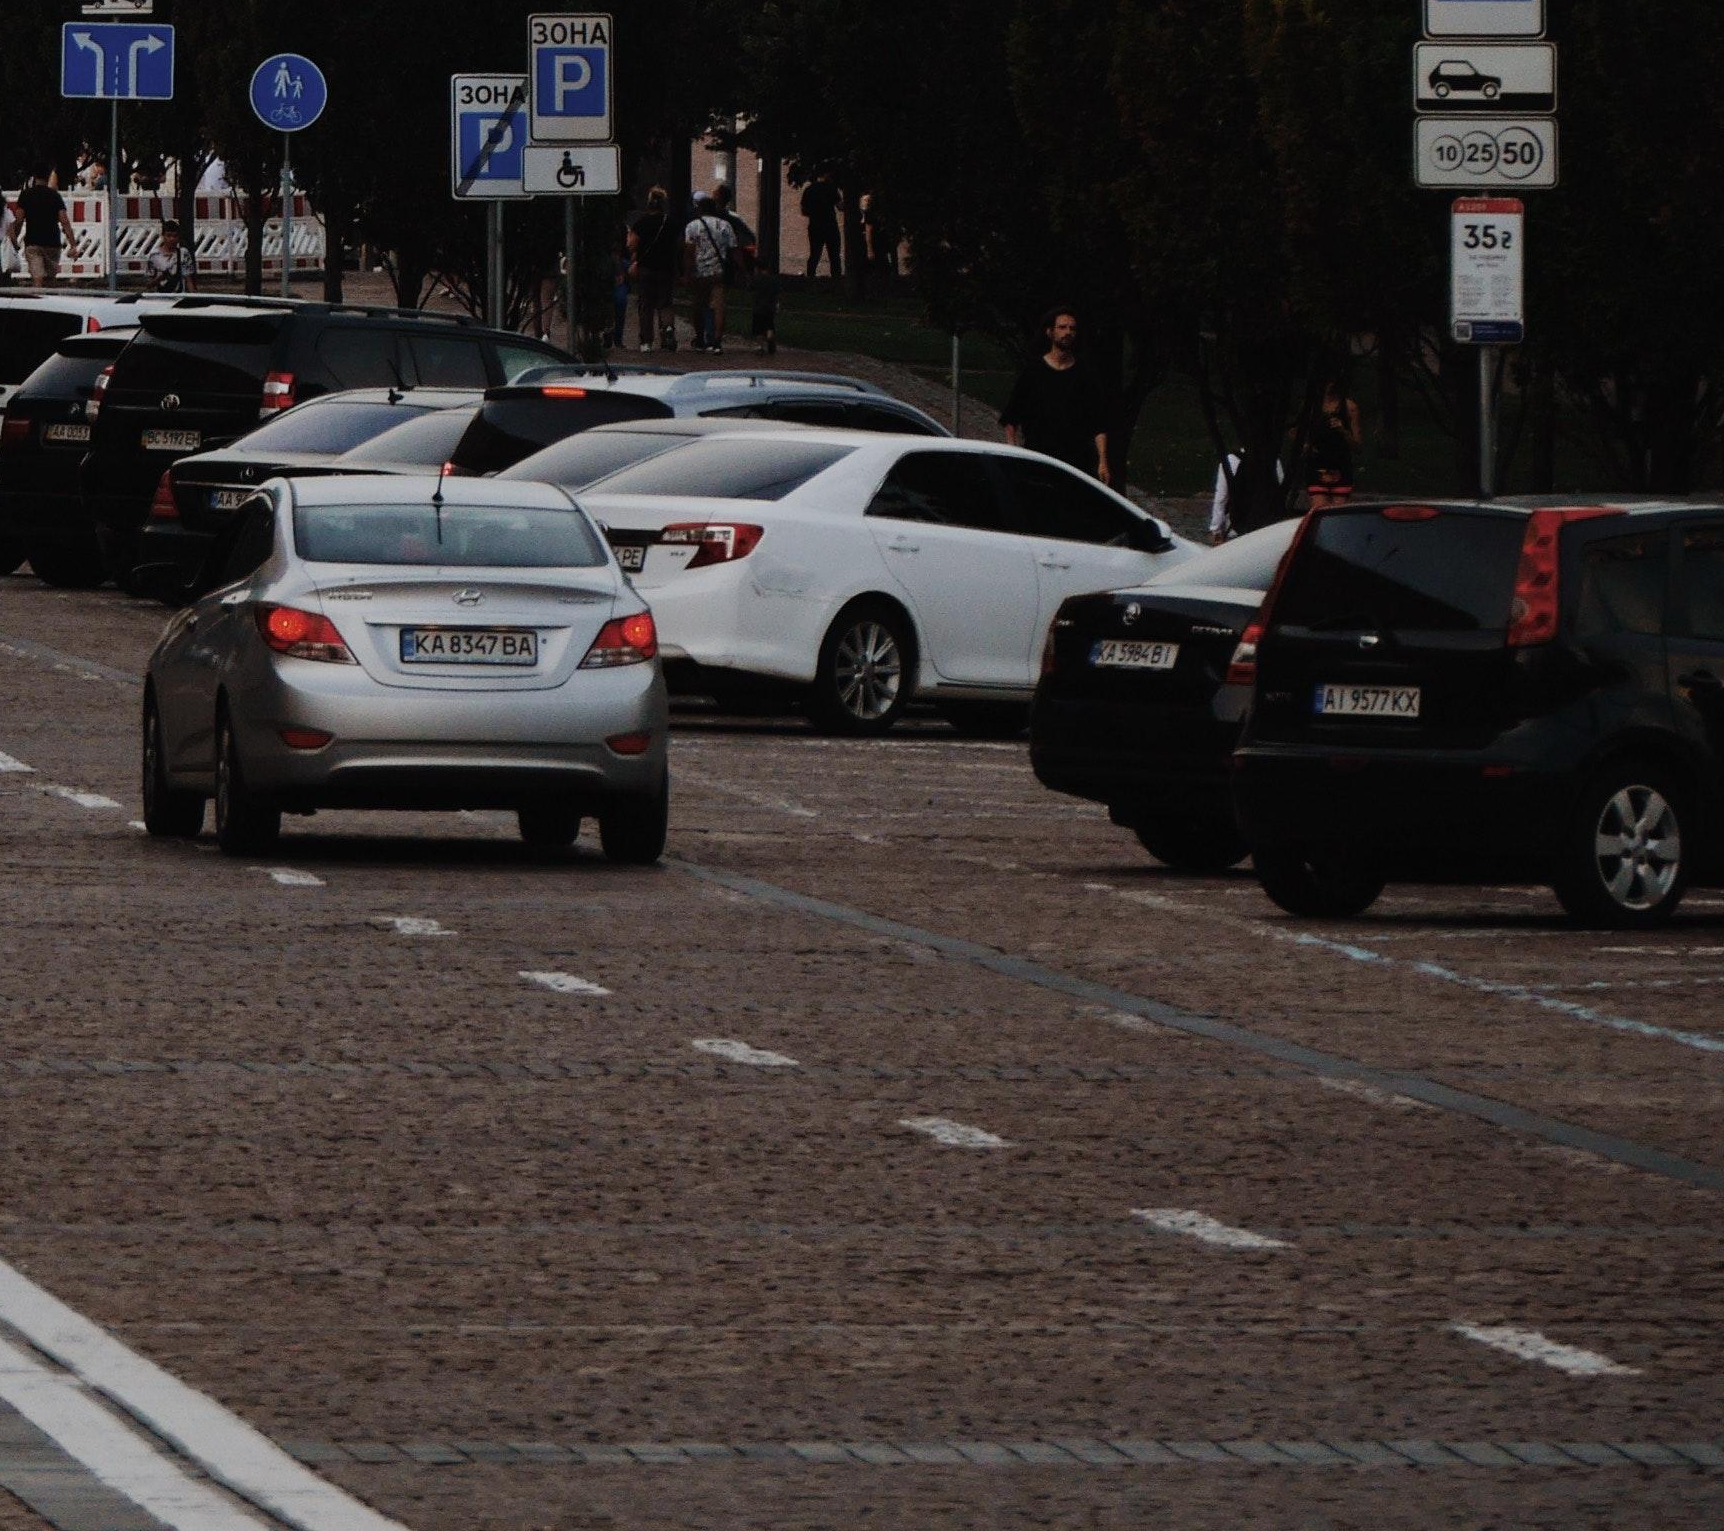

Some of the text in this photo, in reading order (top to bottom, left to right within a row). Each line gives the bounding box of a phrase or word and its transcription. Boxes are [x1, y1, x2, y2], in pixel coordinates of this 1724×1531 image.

[533, 22, 607, 45] ЗОНА
[461, 85, 526, 104] ЗОНА
[555, 55, 592, 111] P
[479, 119, 513, 173] P
[1436, 142, 1535, 164] 10 25 50
[1464, 225, 1497, 249] 35
[622, 549, 641, 565] PE
[415, 635, 532, 655] KA 8347 BA
[1324, 689, 1417, 713] AI 9577 KX
